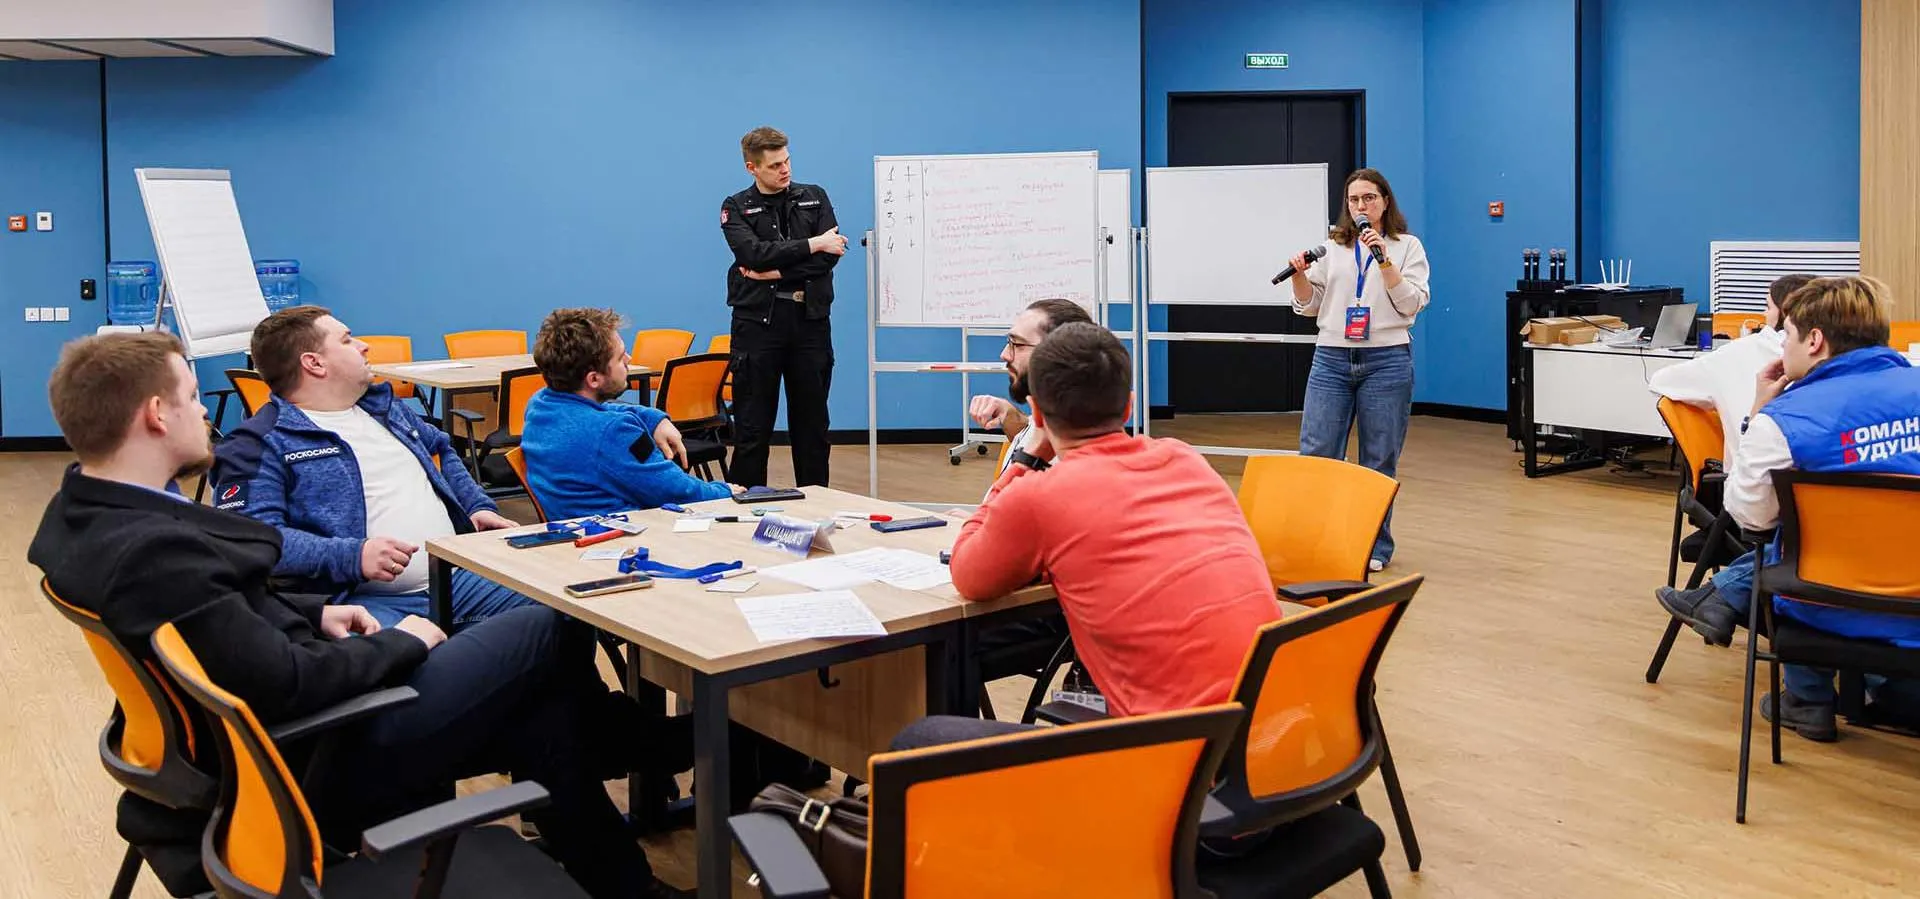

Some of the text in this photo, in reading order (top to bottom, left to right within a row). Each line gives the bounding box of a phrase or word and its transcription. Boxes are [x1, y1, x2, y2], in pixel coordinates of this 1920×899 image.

[1250, 56, 1284, 66] ВЫХОД
[887, 166, 895, 182] 1
[883, 191, 895, 205] 2
[884, 211, 896, 229] 3
[887, 235, 895, 255] 4
[1840, 416, 1919, 448] КОМАН
[284, 446, 340, 462] РОСКОСМОС
